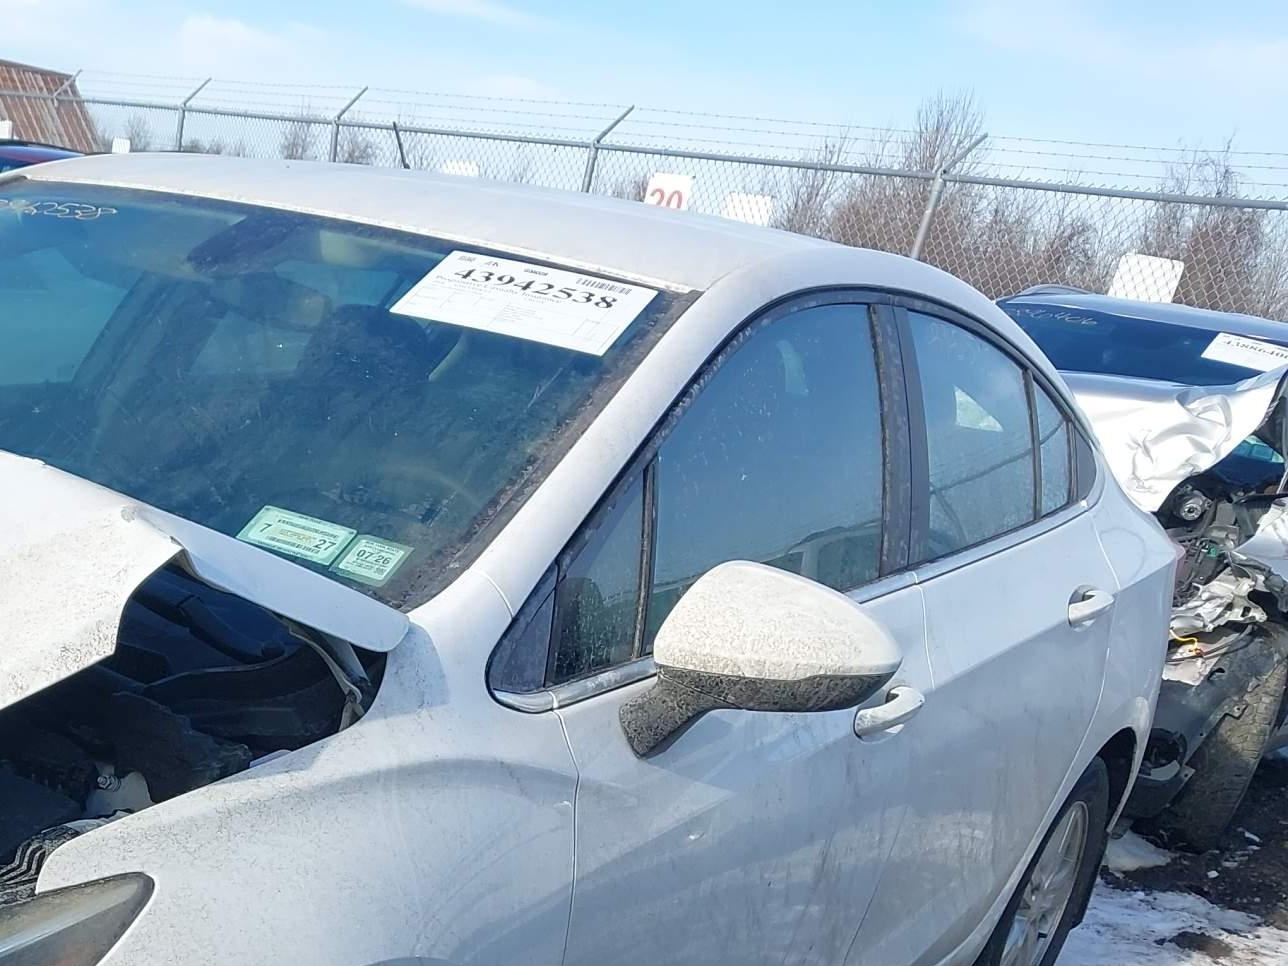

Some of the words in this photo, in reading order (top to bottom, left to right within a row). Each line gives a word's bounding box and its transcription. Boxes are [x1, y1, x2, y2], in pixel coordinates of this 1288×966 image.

[454, 268, 617, 309] 43942538
[259, 522, 273, 533] 7
[312, 538, 337, 551] 27
